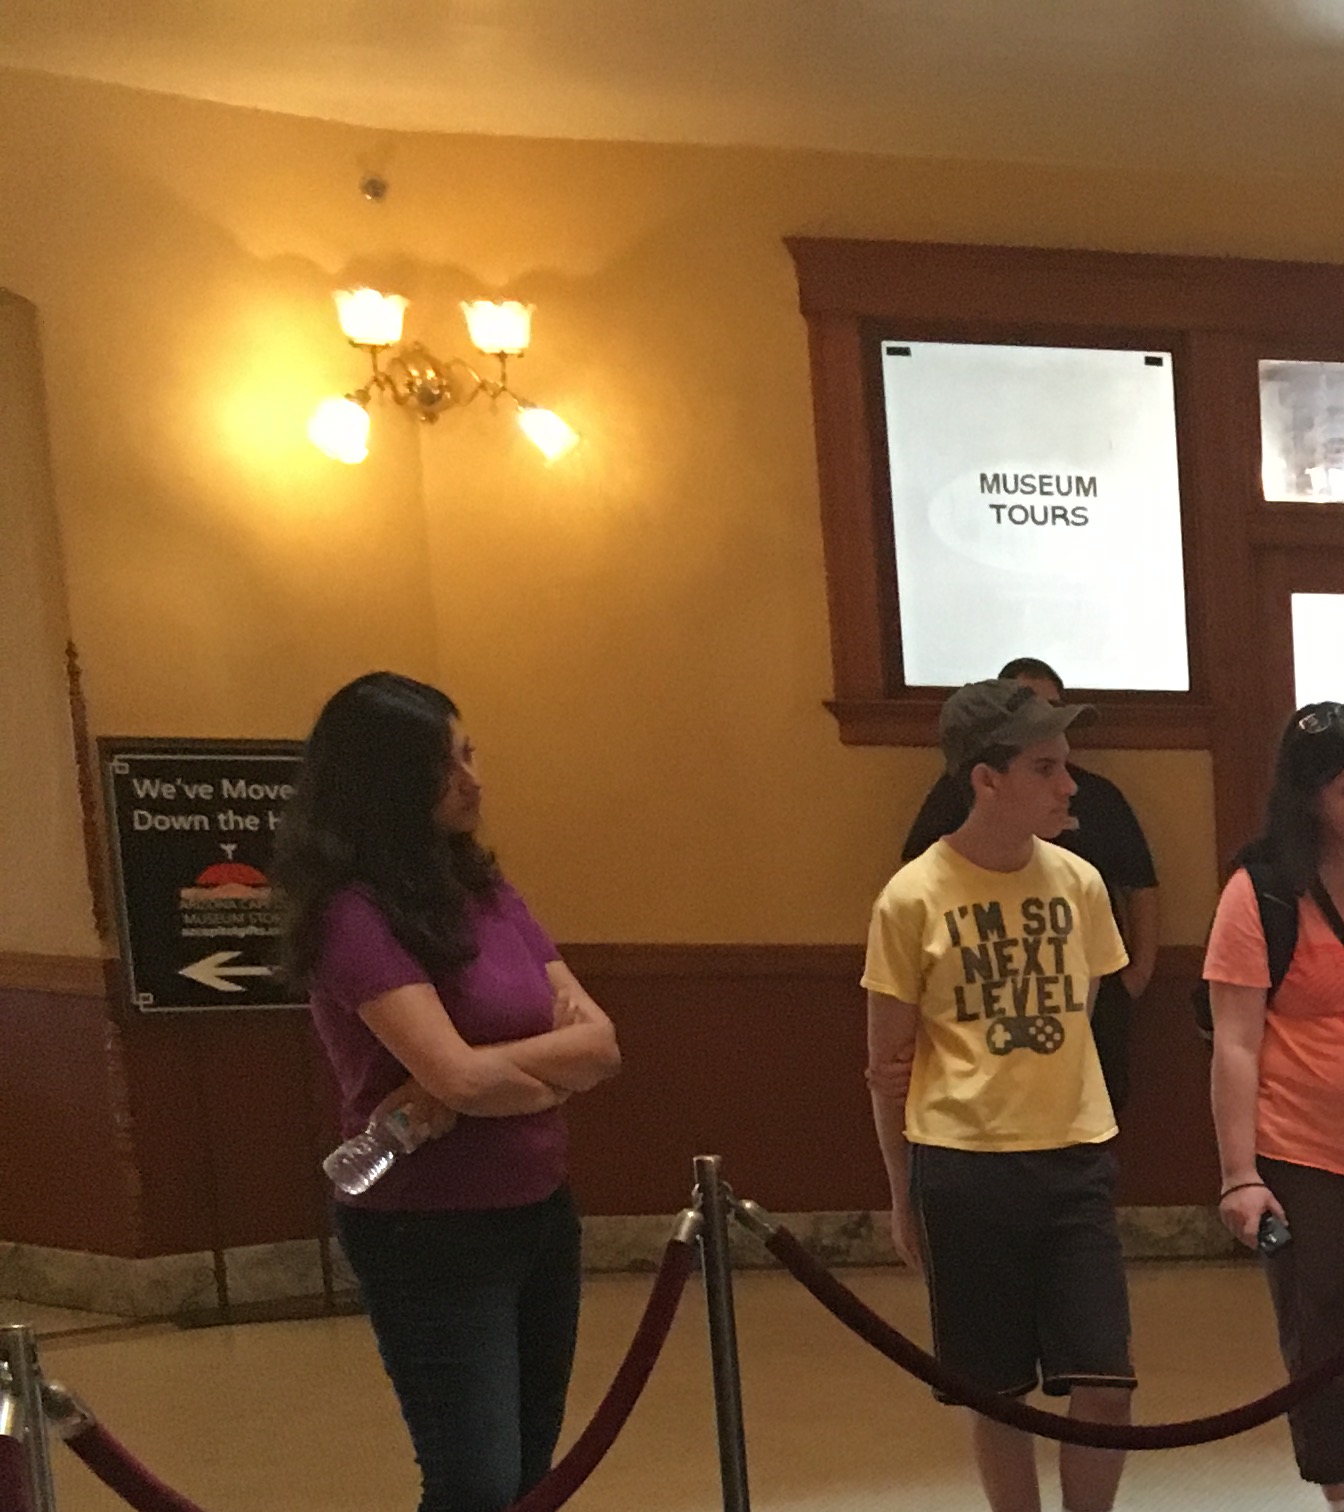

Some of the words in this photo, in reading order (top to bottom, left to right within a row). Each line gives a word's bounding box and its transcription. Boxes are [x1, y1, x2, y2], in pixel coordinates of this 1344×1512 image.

[979, 472, 1098, 497] MUSEUM
[988, 503, 1090, 527] TOURS
[132, 777, 214, 800] We've
[221, 778, 297, 800] Move
[133, 808, 210, 831] Down
[217, 809, 261, 831] the
[943, 901, 1008, 947] I'M
[1021, 896, 1074, 937] SO
[960, 937, 1068, 985] NEXT
[953, 974, 1085, 1023] LEVEL
